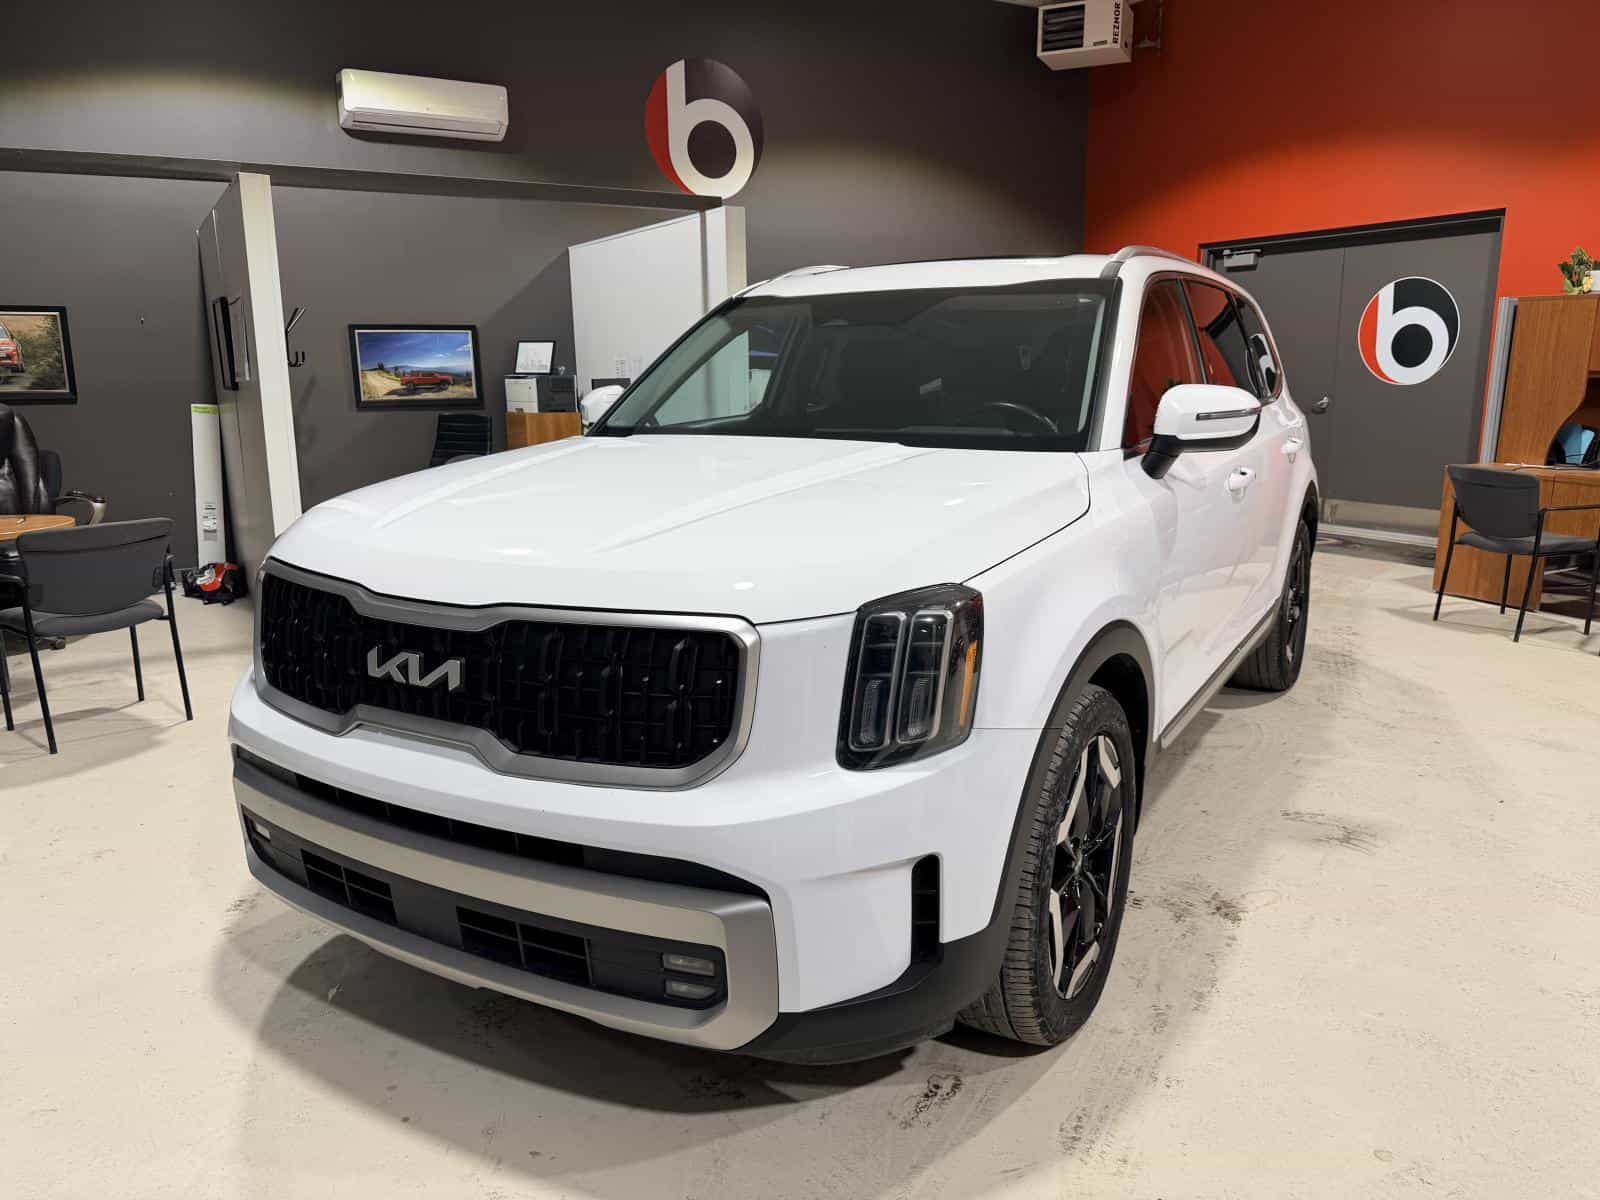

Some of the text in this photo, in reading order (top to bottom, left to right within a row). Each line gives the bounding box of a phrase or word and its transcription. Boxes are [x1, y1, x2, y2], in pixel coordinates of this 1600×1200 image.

[1112, 2, 1121, 44] REZNOR
[666, 58, 755, 200] b
[1375, 281, 1449, 385] b
[367, 646, 463, 691] KIA
